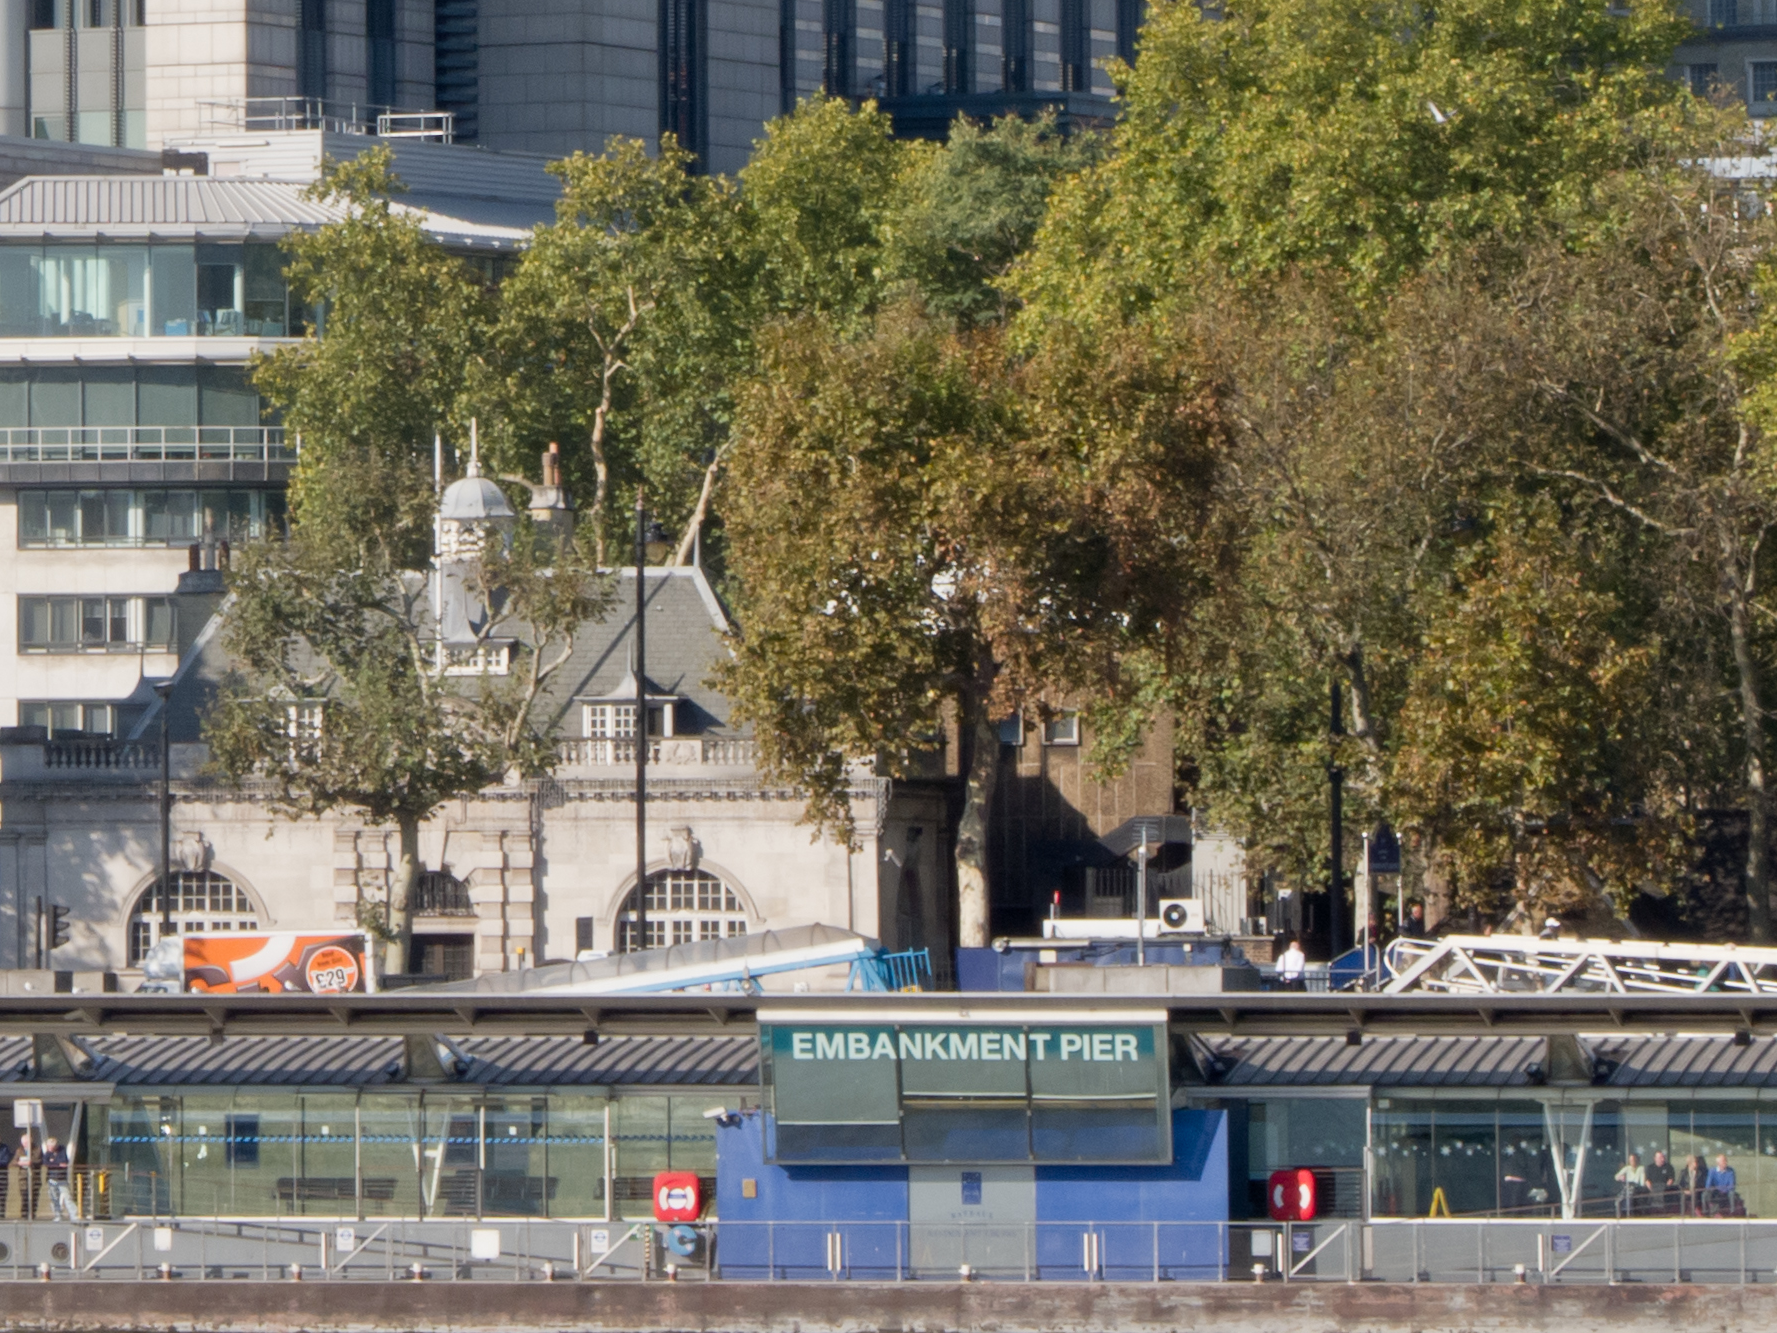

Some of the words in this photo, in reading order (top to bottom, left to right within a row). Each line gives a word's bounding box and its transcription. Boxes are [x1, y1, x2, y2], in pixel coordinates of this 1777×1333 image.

[315, 968, 346, 988] £29
[792, 1032, 1051, 1060] EMBANKMENT
[1060, 1033, 1139, 1061] PIER
